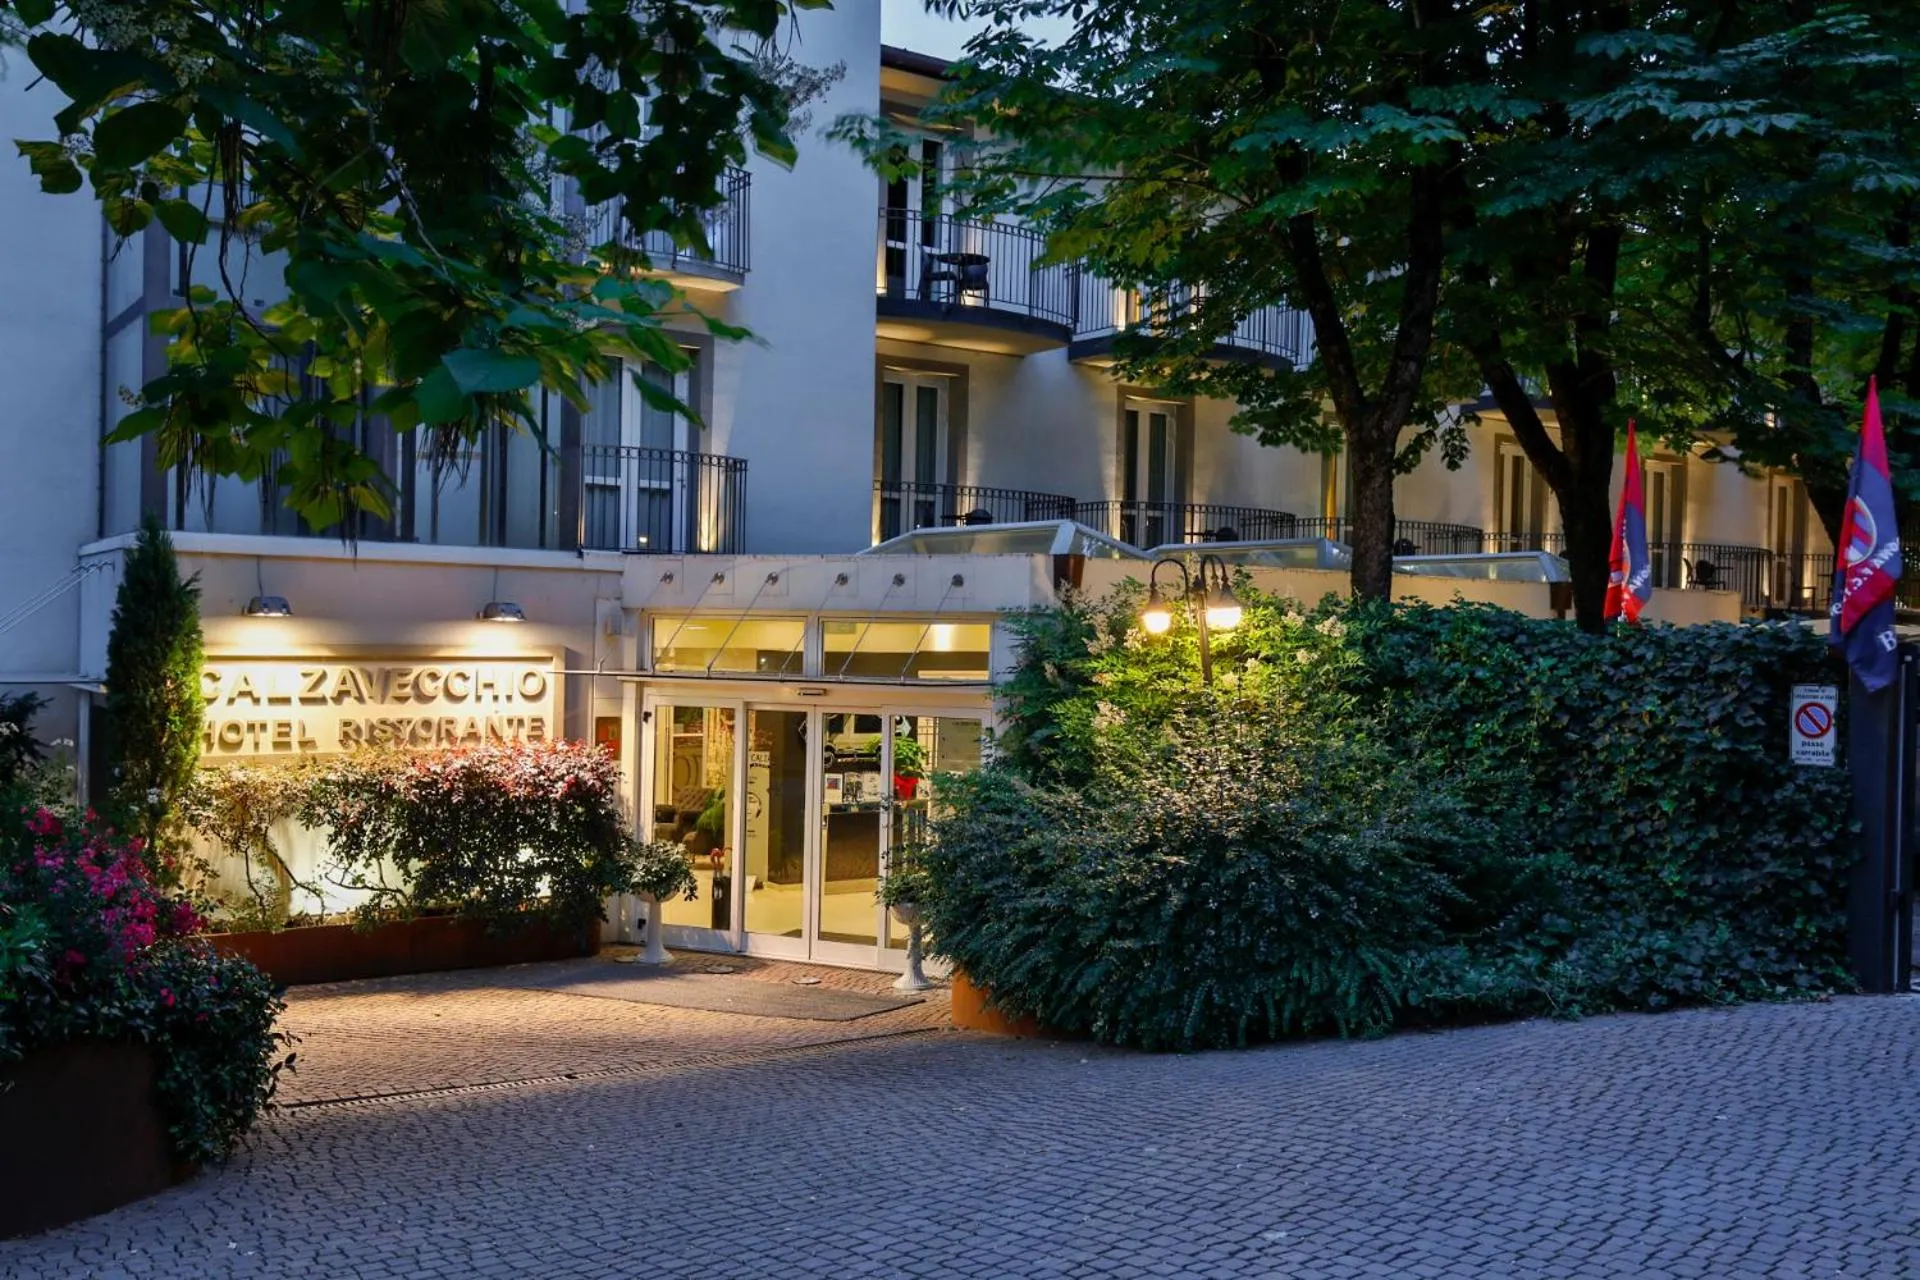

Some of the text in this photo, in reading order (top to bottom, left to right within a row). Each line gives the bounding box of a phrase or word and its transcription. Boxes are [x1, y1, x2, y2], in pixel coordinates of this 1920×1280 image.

[201, 667, 547, 704] CALZAVECCHIO
[202, 715, 546, 751] HOTEL RISTORANTE
